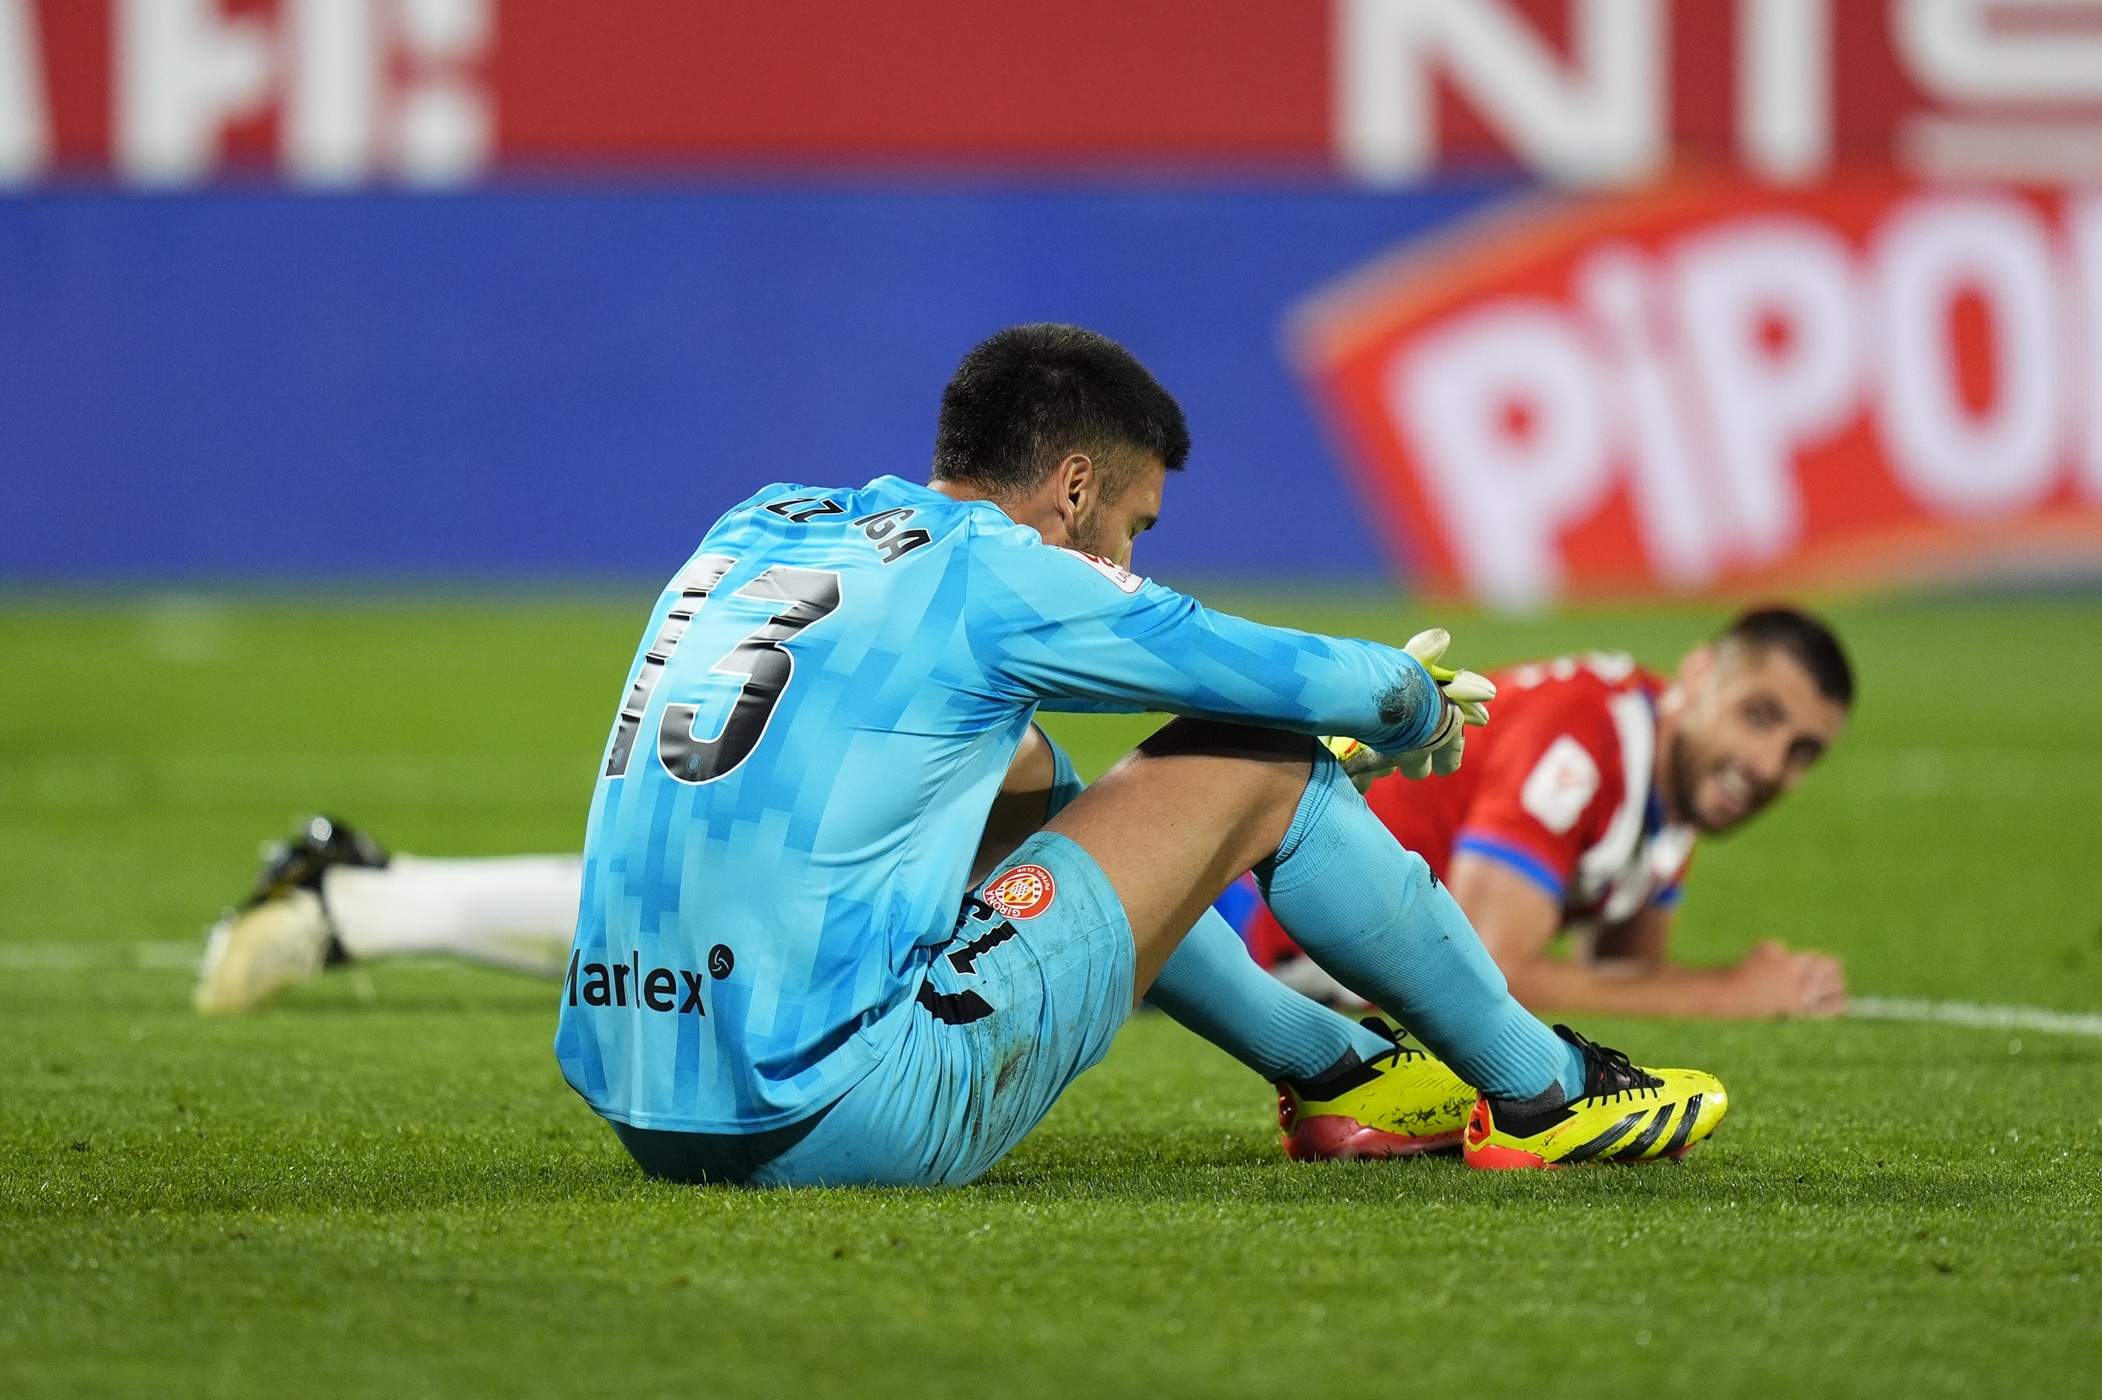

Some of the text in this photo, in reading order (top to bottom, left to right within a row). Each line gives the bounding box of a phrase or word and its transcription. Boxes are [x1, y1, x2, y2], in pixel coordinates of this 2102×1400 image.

[1385, 200, 2102, 614] PiPO
[605, 554, 840, 786] 13
[985, 889, 1020, 917] GIRONA
